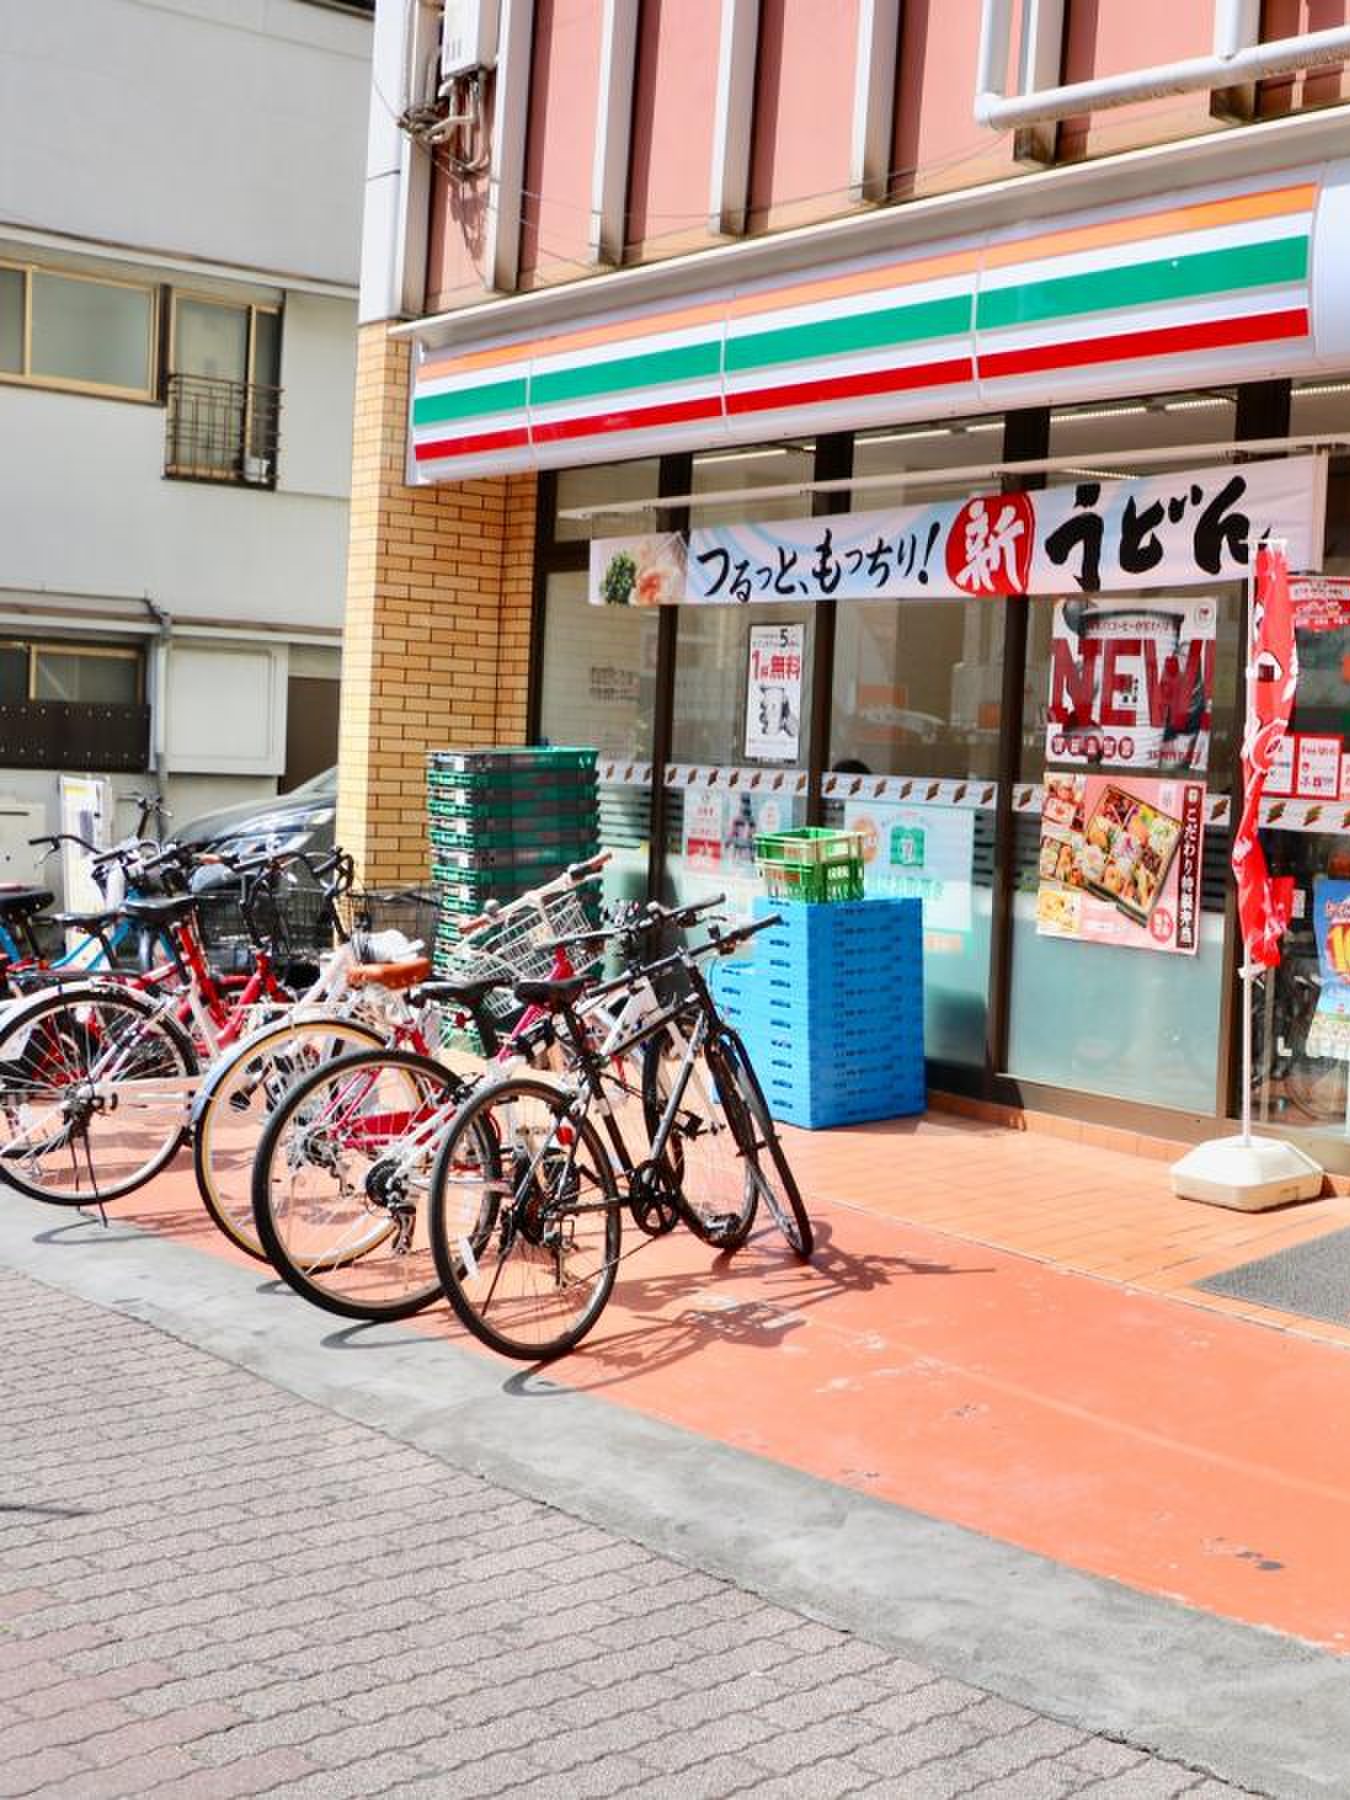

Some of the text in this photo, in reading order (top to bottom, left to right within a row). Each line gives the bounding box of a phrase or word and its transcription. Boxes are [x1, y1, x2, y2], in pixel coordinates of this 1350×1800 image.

[956, 499, 1025, 592] 新
[1045, 476, 1271, 592] うどん
